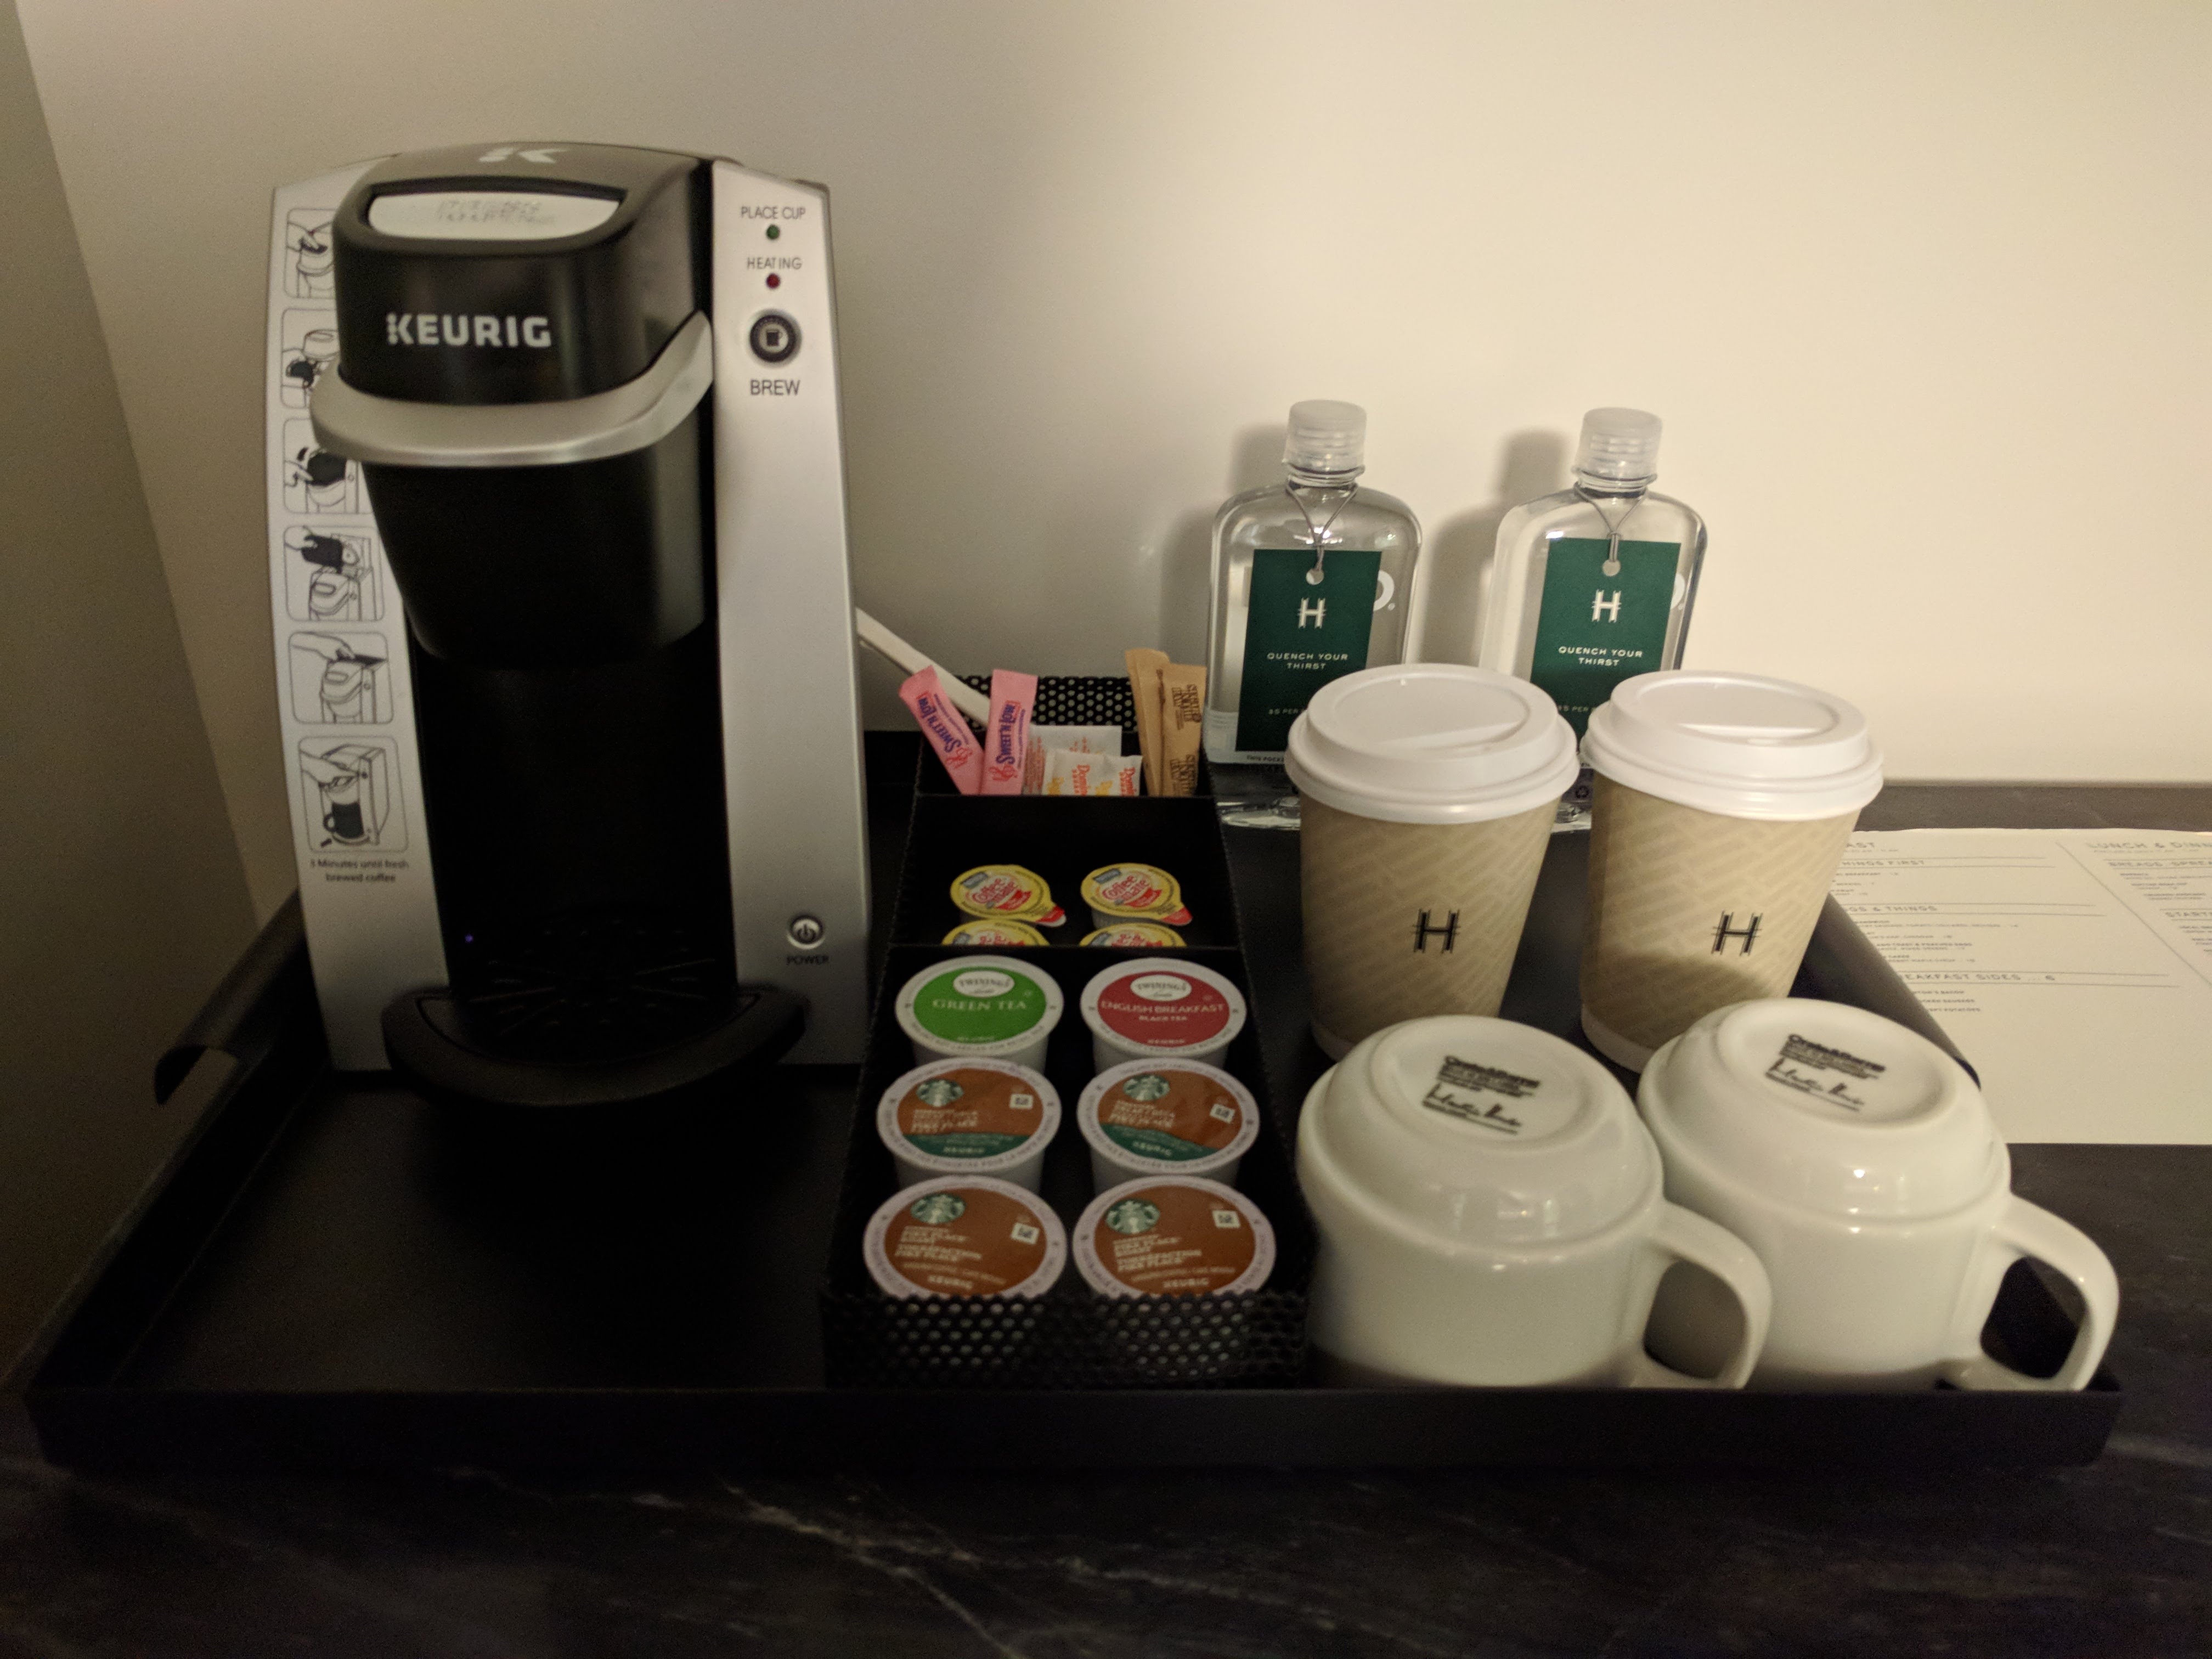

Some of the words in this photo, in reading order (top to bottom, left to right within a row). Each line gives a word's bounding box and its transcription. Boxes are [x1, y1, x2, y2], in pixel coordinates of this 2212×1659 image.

[741, 206, 778, 219] PLACE
[783, 207, 805, 220] CUP
[747, 257, 803, 270] HEATING
[386, 313, 552, 347] KEURIG
[750, 379, 801, 396] BREW
[1297, 597, 1327, 629] H
[1593, 589, 1622, 623] H
[1267, 652, 1314, 661] QUENCH
[1318, 653, 1348, 661] YOUR
[1558, 646, 1607, 656] QUENCH
[1611, 649, 1643, 658] YOUR
[1578, 657, 1620, 667] THIRST
[1412, 909, 1460, 954] H
[1711, 910, 1763, 956] H
[786, 955, 829, 965] POWER
[932, 998, 991, 1011] GREEN
[997, 1000, 1027, 1011] TEA
[1099, 1000, 1153, 1014] ENGLISH
[1154, 1003, 1224, 1014] BREAKFAST
